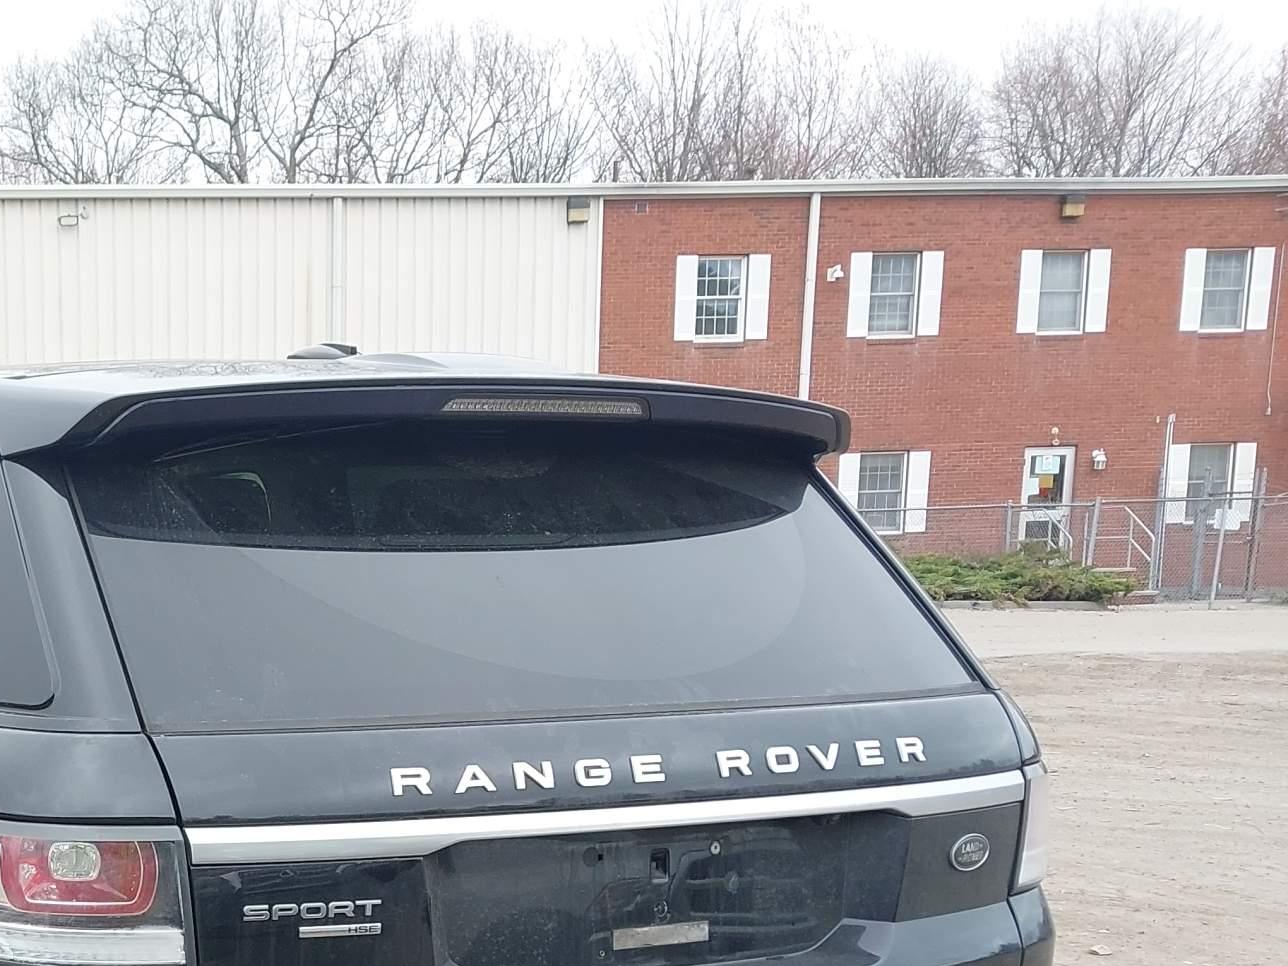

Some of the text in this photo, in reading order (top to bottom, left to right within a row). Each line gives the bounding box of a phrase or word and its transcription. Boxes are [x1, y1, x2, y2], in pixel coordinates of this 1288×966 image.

[390, 736, 927, 796] RANGE ROVER
[243, 899, 382, 921] SPORT
[347, 925, 380, 934] HSE
